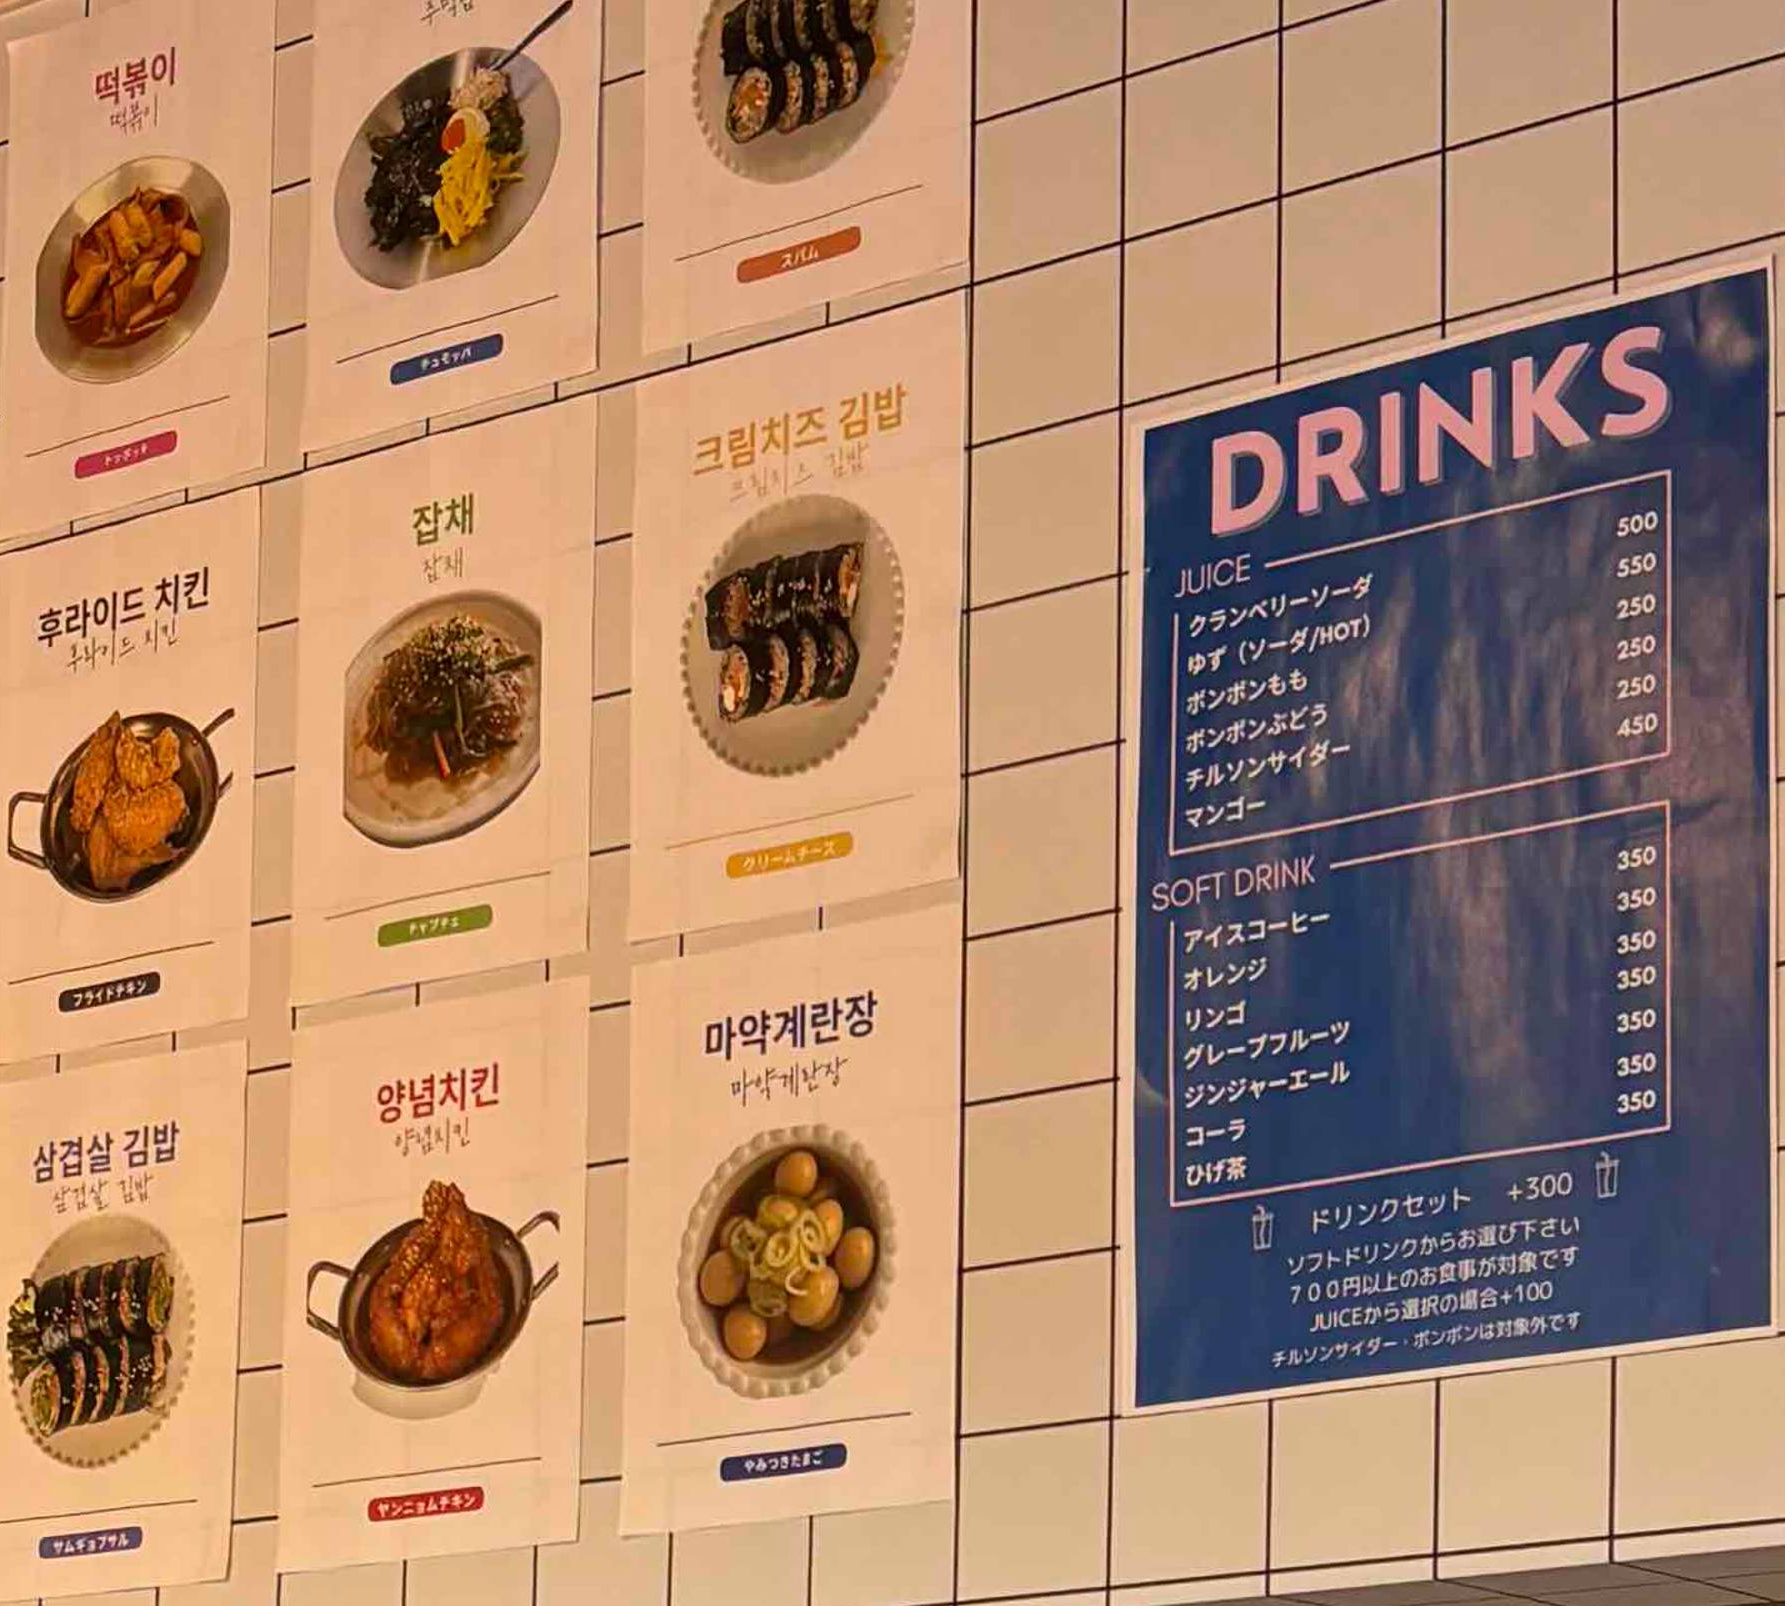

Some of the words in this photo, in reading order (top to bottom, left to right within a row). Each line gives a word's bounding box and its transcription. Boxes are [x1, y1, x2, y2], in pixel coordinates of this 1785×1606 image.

[94, 46, 176, 104] 떡볶이
[780, 246, 819, 269] スパム
[691, 407, 828, 475] 크림치즈
[839, 384, 908, 440] 김밥
[1211, 326, 1672, 536] DRINKS
[412, 493, 475, 546] 잡채
[421, 548, 465, 583] 잡채
[1174, 553, 1251, 598] JUICE
[1189, 572, 1374, 638] クランベリーソーダ
[1616, 511, 1658, 539] 500
[1616, 552, 1657, 579] 550
[37, 588, 146, 648] 후라이드
[154, 566, 210, 614] 치킨
[1616, 593, 1656, 620] 250
[1616, 635, 1656, 662] 250
[1185, 743, 1350, 793] チルソンサイダー
[1616, 674, 1656, 701] 250
[1185, 795, 1266, 829] マンゴー
[1616, 711, 1658, 739] 450
[742, 838, 837, 872] クリームチーズ
[1150, 873, 1227, 914] SOFT
[1234, 855, 1316, 900] DRINK
[1183, 909, 1330, 953] アイスコーヒー
[1616, 846, 1657, 872] 350
[1183, 957, 1267, 993] オレンジ
[1616, 887, 1657, 913] 350
[73, 978, 148, 1007] フライドチキン
[1185, 1000, 1247, 1031] リンゴ
[1616, 929, 1657, 955] 350
[705, 991, 878, 1062] 마약계란장
[1183, 1020, 1350, 1072] グレープフルーツ
[1616, 965, 1657, 991] 350
[1184, 1061, 1350, 1109] ジンジャーエール
[1616, 1008, 1657, 1034] 350
[377, 1062, 500, 1124] 양념치킨
[1186, 1118, 1247, 1149] コーラ
[1616, 1052, 1657, 1078] 350
[33, 1133, 115, 1184] 삼겹살
[122, 1120, 180, 1168] 김밥
[1185, 1156, 1248, 1187] ひげ茶
[1616, 1090, 1657, 1116] 350
[1310, 1187, 1471, 1236] ドリンクセット
[1508, 1173, 1573, 1204] +300
[1287, 1216, 1580, 1276] ソフトドリンクからお選び下さい
[743, 1449, 822, 1474] やみつきたまご
[376, 1491, 476, 1518] ヤンニョムチキン
